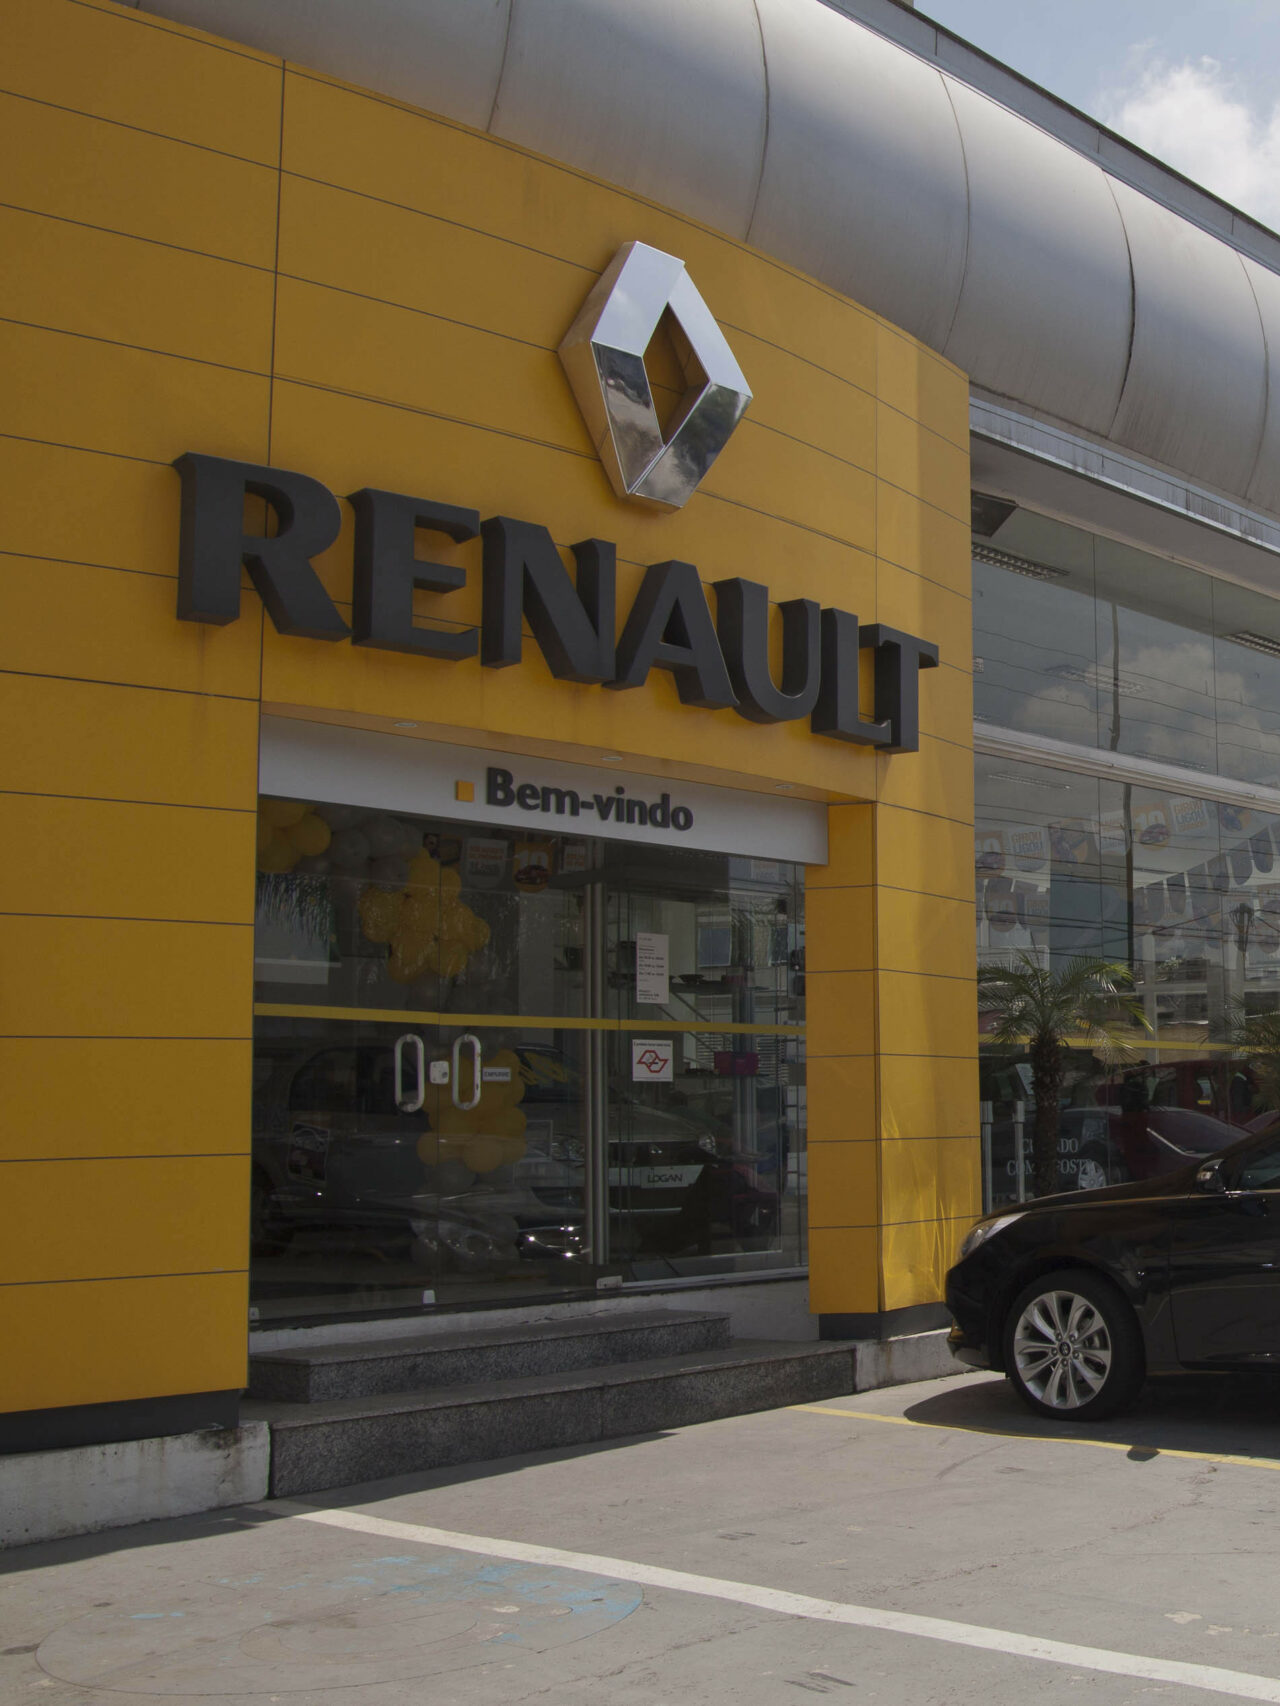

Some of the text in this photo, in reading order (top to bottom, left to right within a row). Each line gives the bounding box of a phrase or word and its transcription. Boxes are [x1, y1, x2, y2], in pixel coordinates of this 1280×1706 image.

[172, 451, 941, 756] RENAULT
[486, 766, 693, 831] Bem-vindo
[648, 1174, 683, 1183] LOGAN
